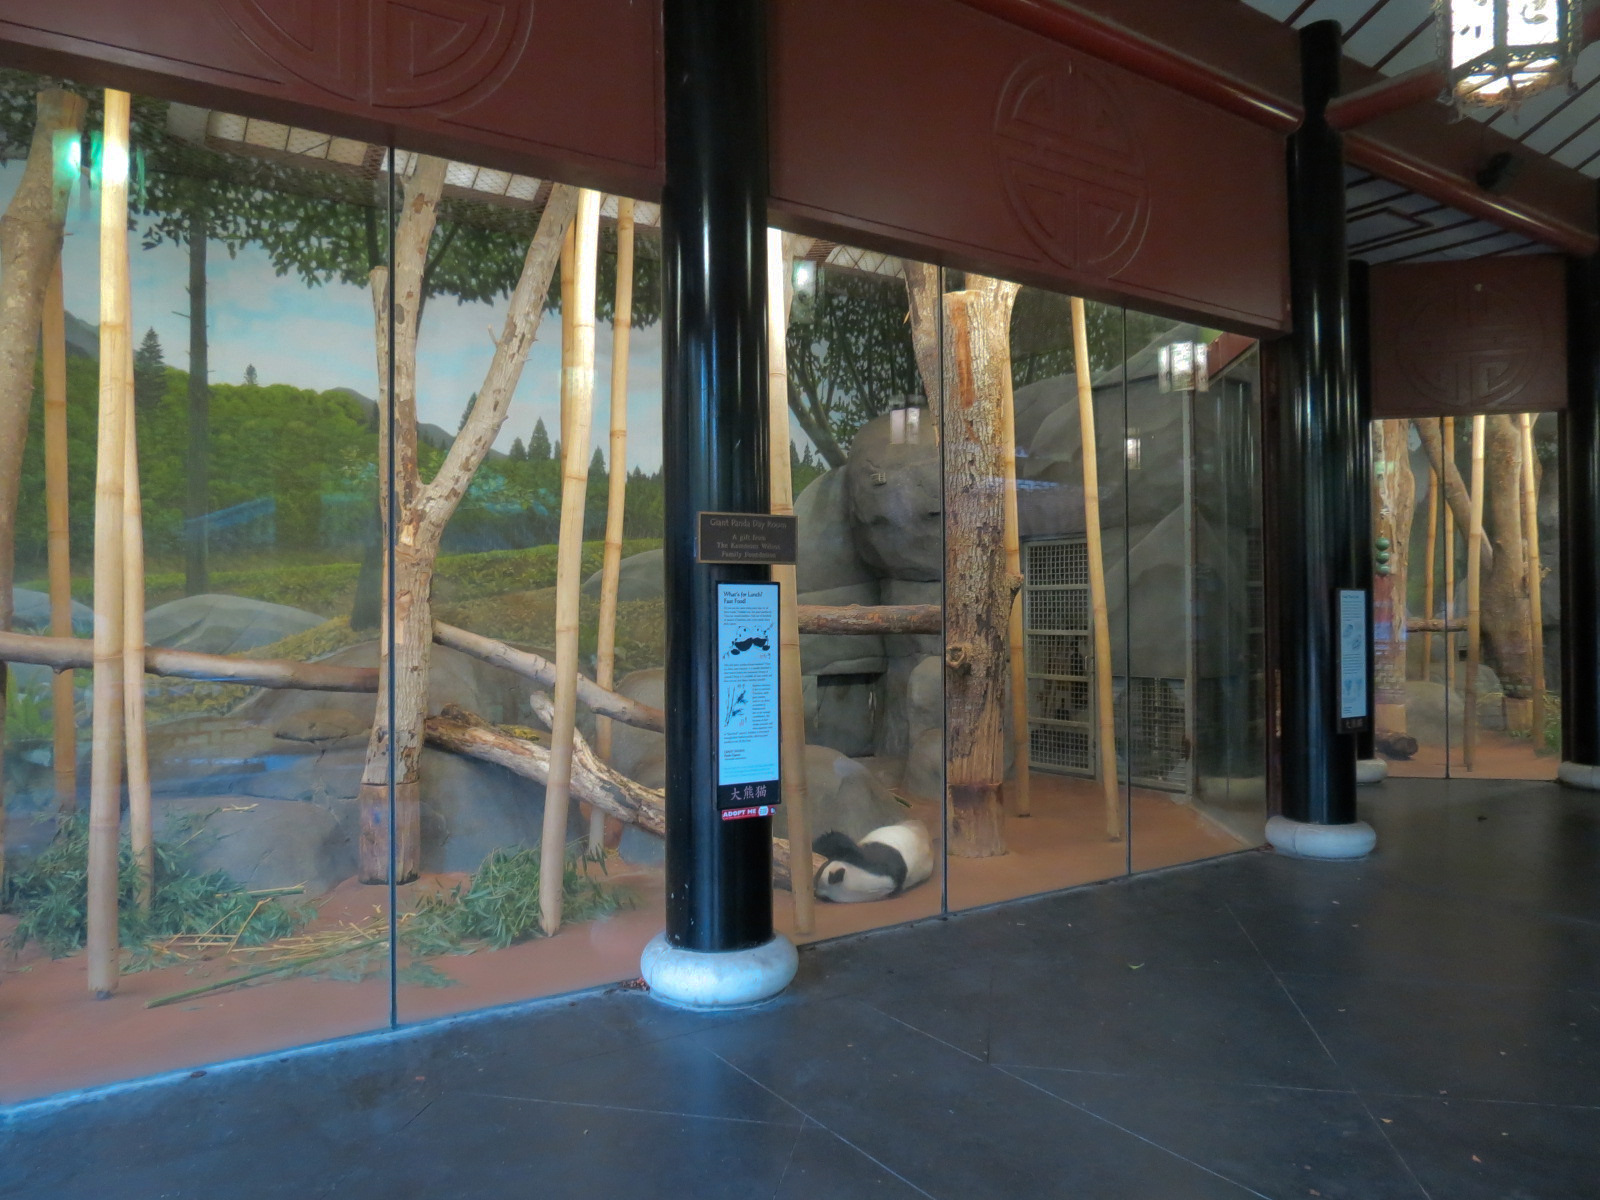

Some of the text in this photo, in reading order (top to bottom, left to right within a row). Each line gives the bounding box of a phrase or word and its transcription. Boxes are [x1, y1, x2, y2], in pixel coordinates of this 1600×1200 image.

[710, 518, 729, 527] Giant
[731, 518, 751, 528] Panda
[752, 519, 765, 530] Day
[740, 534, 751, 542] gift
[721, 550, 742, 559] Family
[730, 784, 767, 801] 大熊猫
[723, 809, 746, 818] ADOPT
[747, 807, 757, 815] ME
